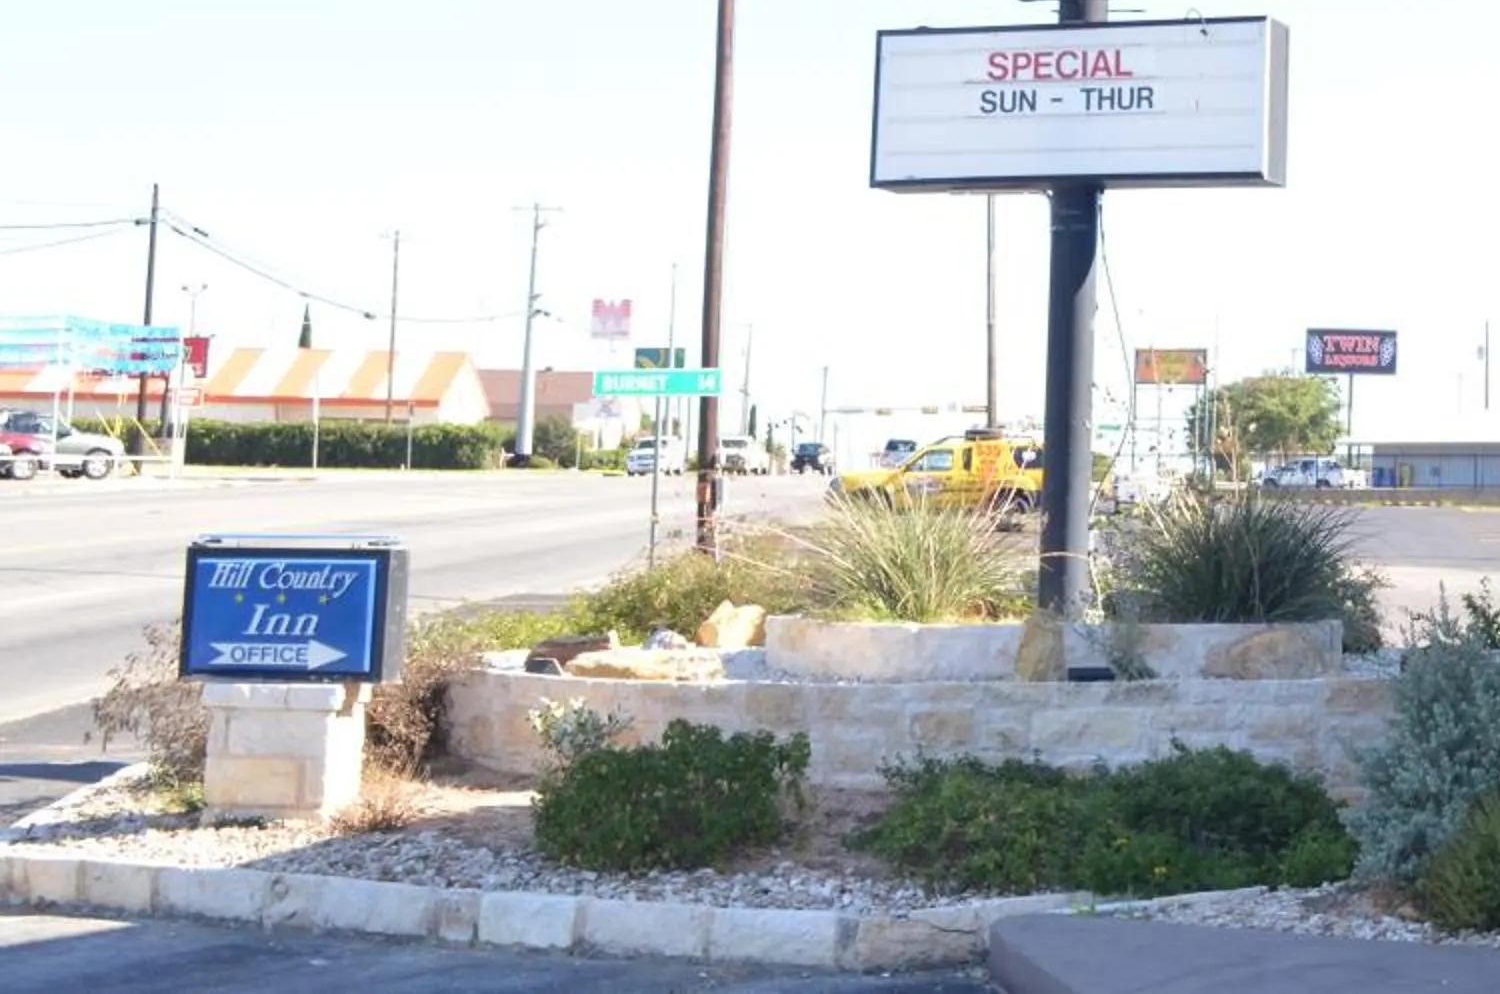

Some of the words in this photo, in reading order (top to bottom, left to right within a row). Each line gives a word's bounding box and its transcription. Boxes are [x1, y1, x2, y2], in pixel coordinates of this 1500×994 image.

[986, 49, 1134, 82] SPECIAL
[979, 89, 1038, 115] SUN
[1080, 86, 1155, 112] THUR
[1323, 335, 1380, 352] TWIN
[208, 561, 253, 589] Hill
[258, 561, 359, 599] Country
[241, 604, 319, 637] Inn
[230, 645, 309, 664] OFFICE
